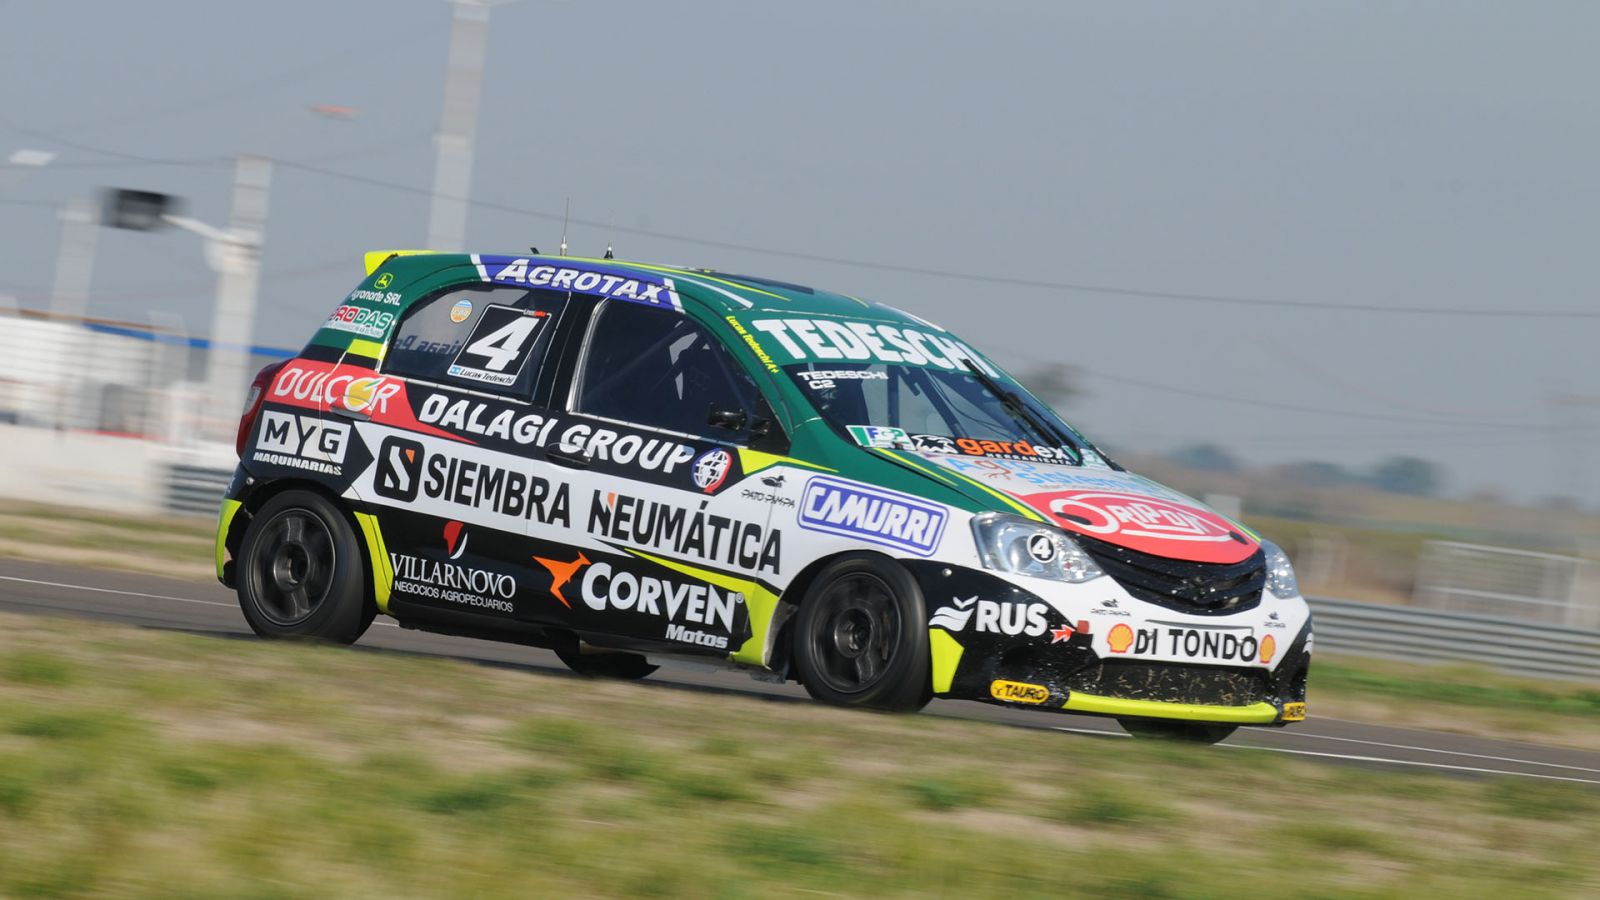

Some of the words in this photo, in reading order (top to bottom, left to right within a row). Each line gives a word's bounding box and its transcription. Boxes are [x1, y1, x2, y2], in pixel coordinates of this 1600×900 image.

[383, 292, 402, 306] SRL
[494, 258, 664, 305] AGROTAX
[466, 316, 540, 371] 4
[752, 319, 1000, 378] TEDESCHI
[273, 367, 401, 414] DULCOR
[460, 368, 482, 379] Lucas
[481, 372, 515, 384] Tedeschi
[797, 370, 889, 381] TEDESCHI
[808, 379, 837, 390] C2
[263, 418, 342, 455] MYG
[418, 393, 558, 448] DALAGI
[559, 423, 695, 475] GROUP
[956, 438, 1070, 460] gardex
[252, 451, 343, 477] MAQUINARIAS
[423, 453, 571, 529] SIEMBRA
[586, 489, 782, 573] NEUMÁTICA
[803, 485, 942, 547] CAMURRI
[1031, 537, 1053, 559] 4
[390, 552, 516, 599] VILLARNOVO
[394, 580, 440, 599] NEGOCIOS
[440, 590, 514, 613] AGROPECUARIOS
[975, 599, 1050, 637] RUS
[665, 623, 729, 650] Motos
[1134, 628, 1159, 656] DI
[1171, 629, 1258, 663] TONDO
[1005, 684, 1046, 701] TAURO
